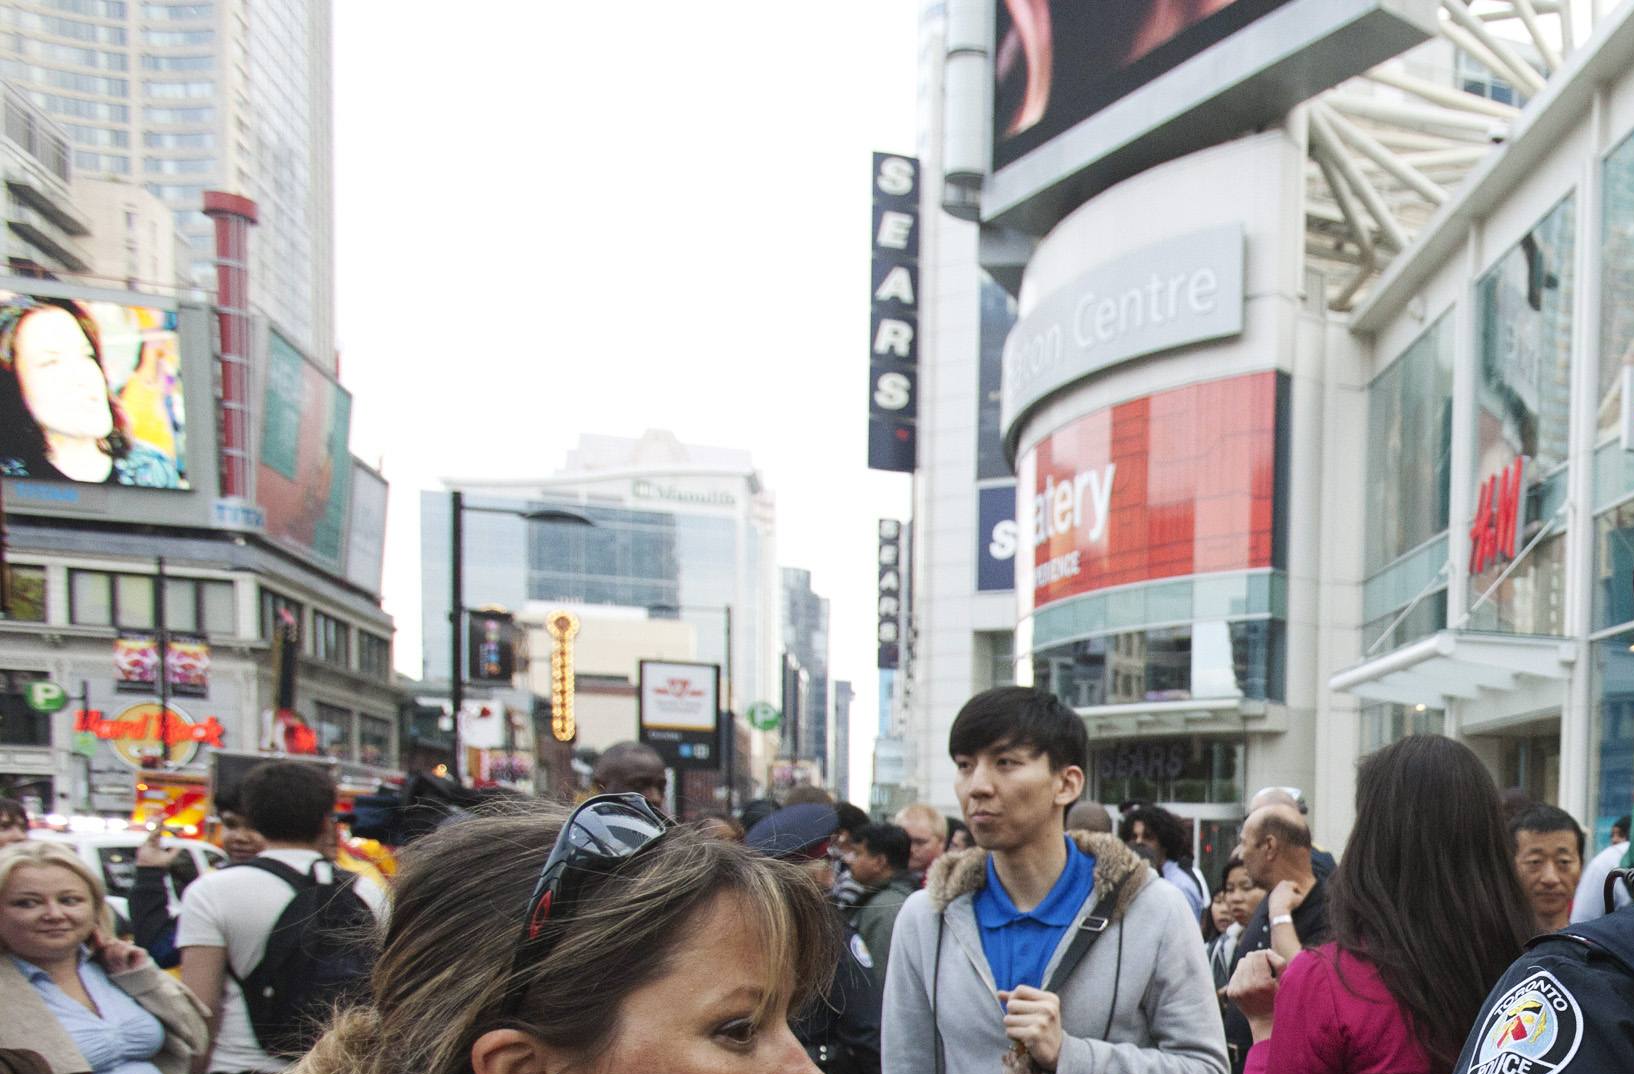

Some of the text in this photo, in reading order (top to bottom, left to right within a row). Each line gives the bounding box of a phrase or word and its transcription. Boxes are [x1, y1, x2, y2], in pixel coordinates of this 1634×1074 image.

[874, 156, 915, 411] SEARS
[1073, 267, 1217, 348] Centre
[32, 684, 59, 705] P
[1494, 979, 1568, 1017] TORONTO
